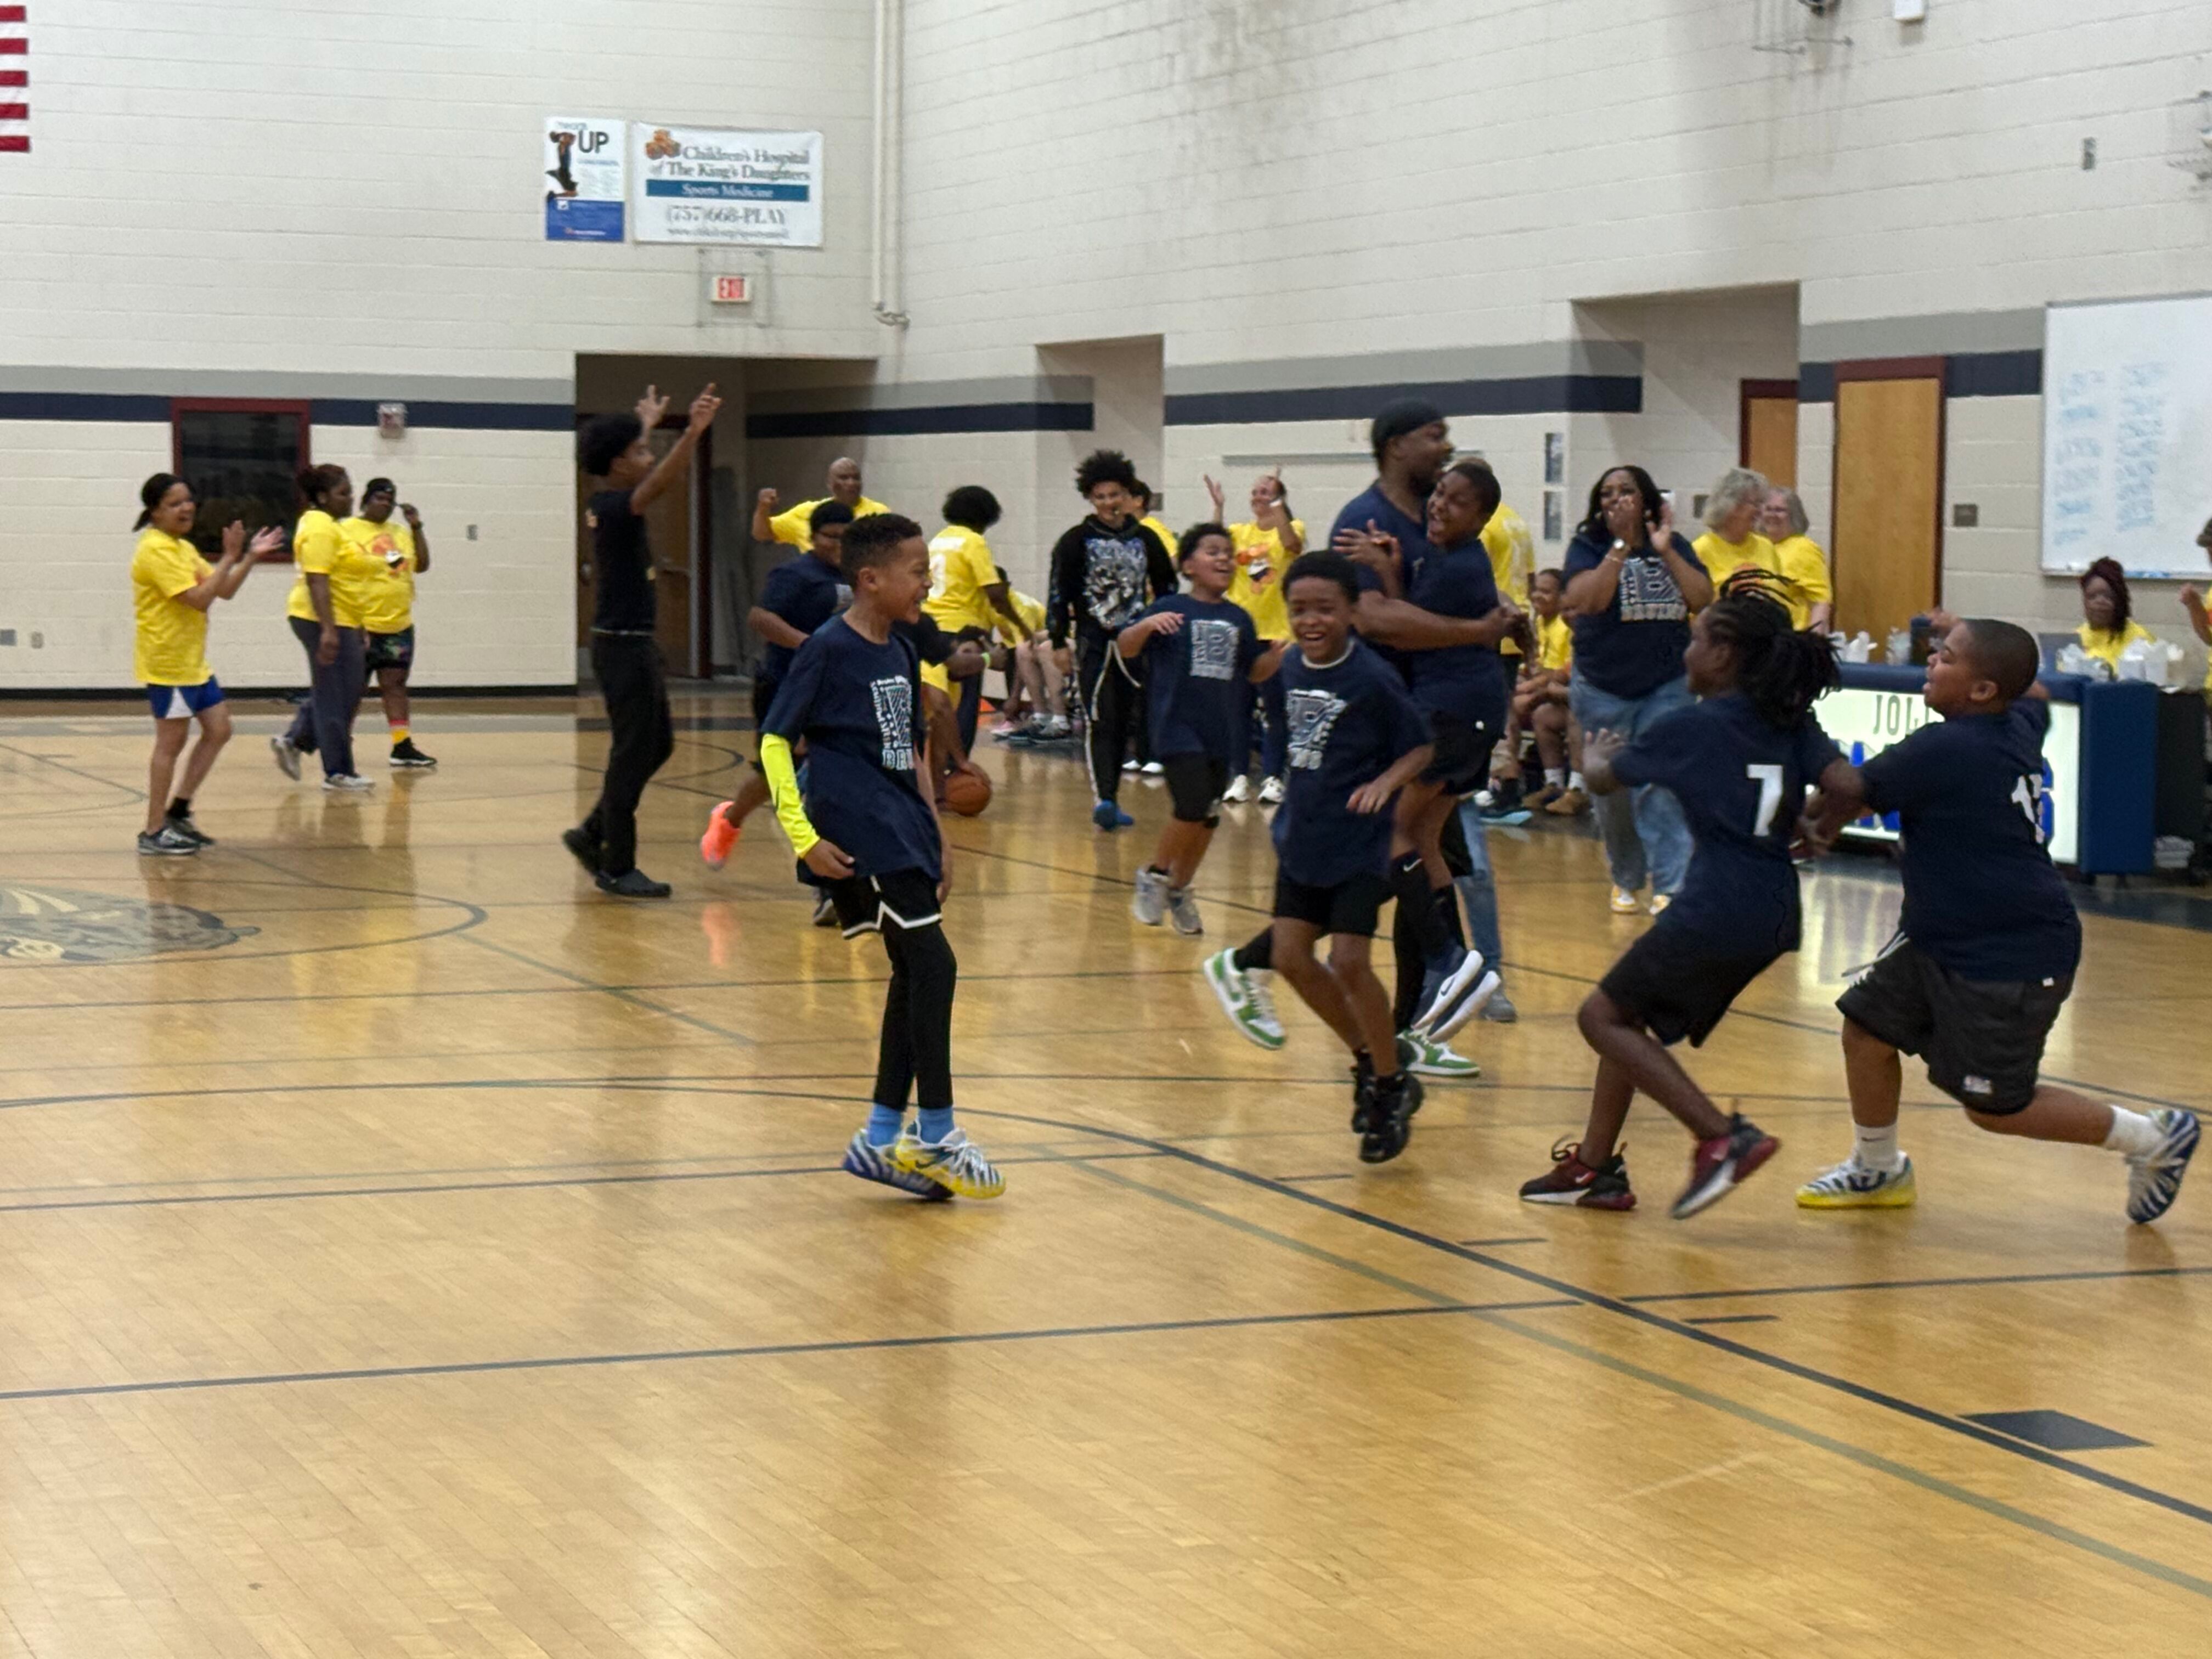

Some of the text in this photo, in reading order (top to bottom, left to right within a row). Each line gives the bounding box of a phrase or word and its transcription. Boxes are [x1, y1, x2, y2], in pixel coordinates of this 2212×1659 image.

[578, 129, 609, 153] UP
[754, 148, 810, 165] Hospital
[666, 161, 695, 176] The
[1746, 764, 1784, 837] 7
